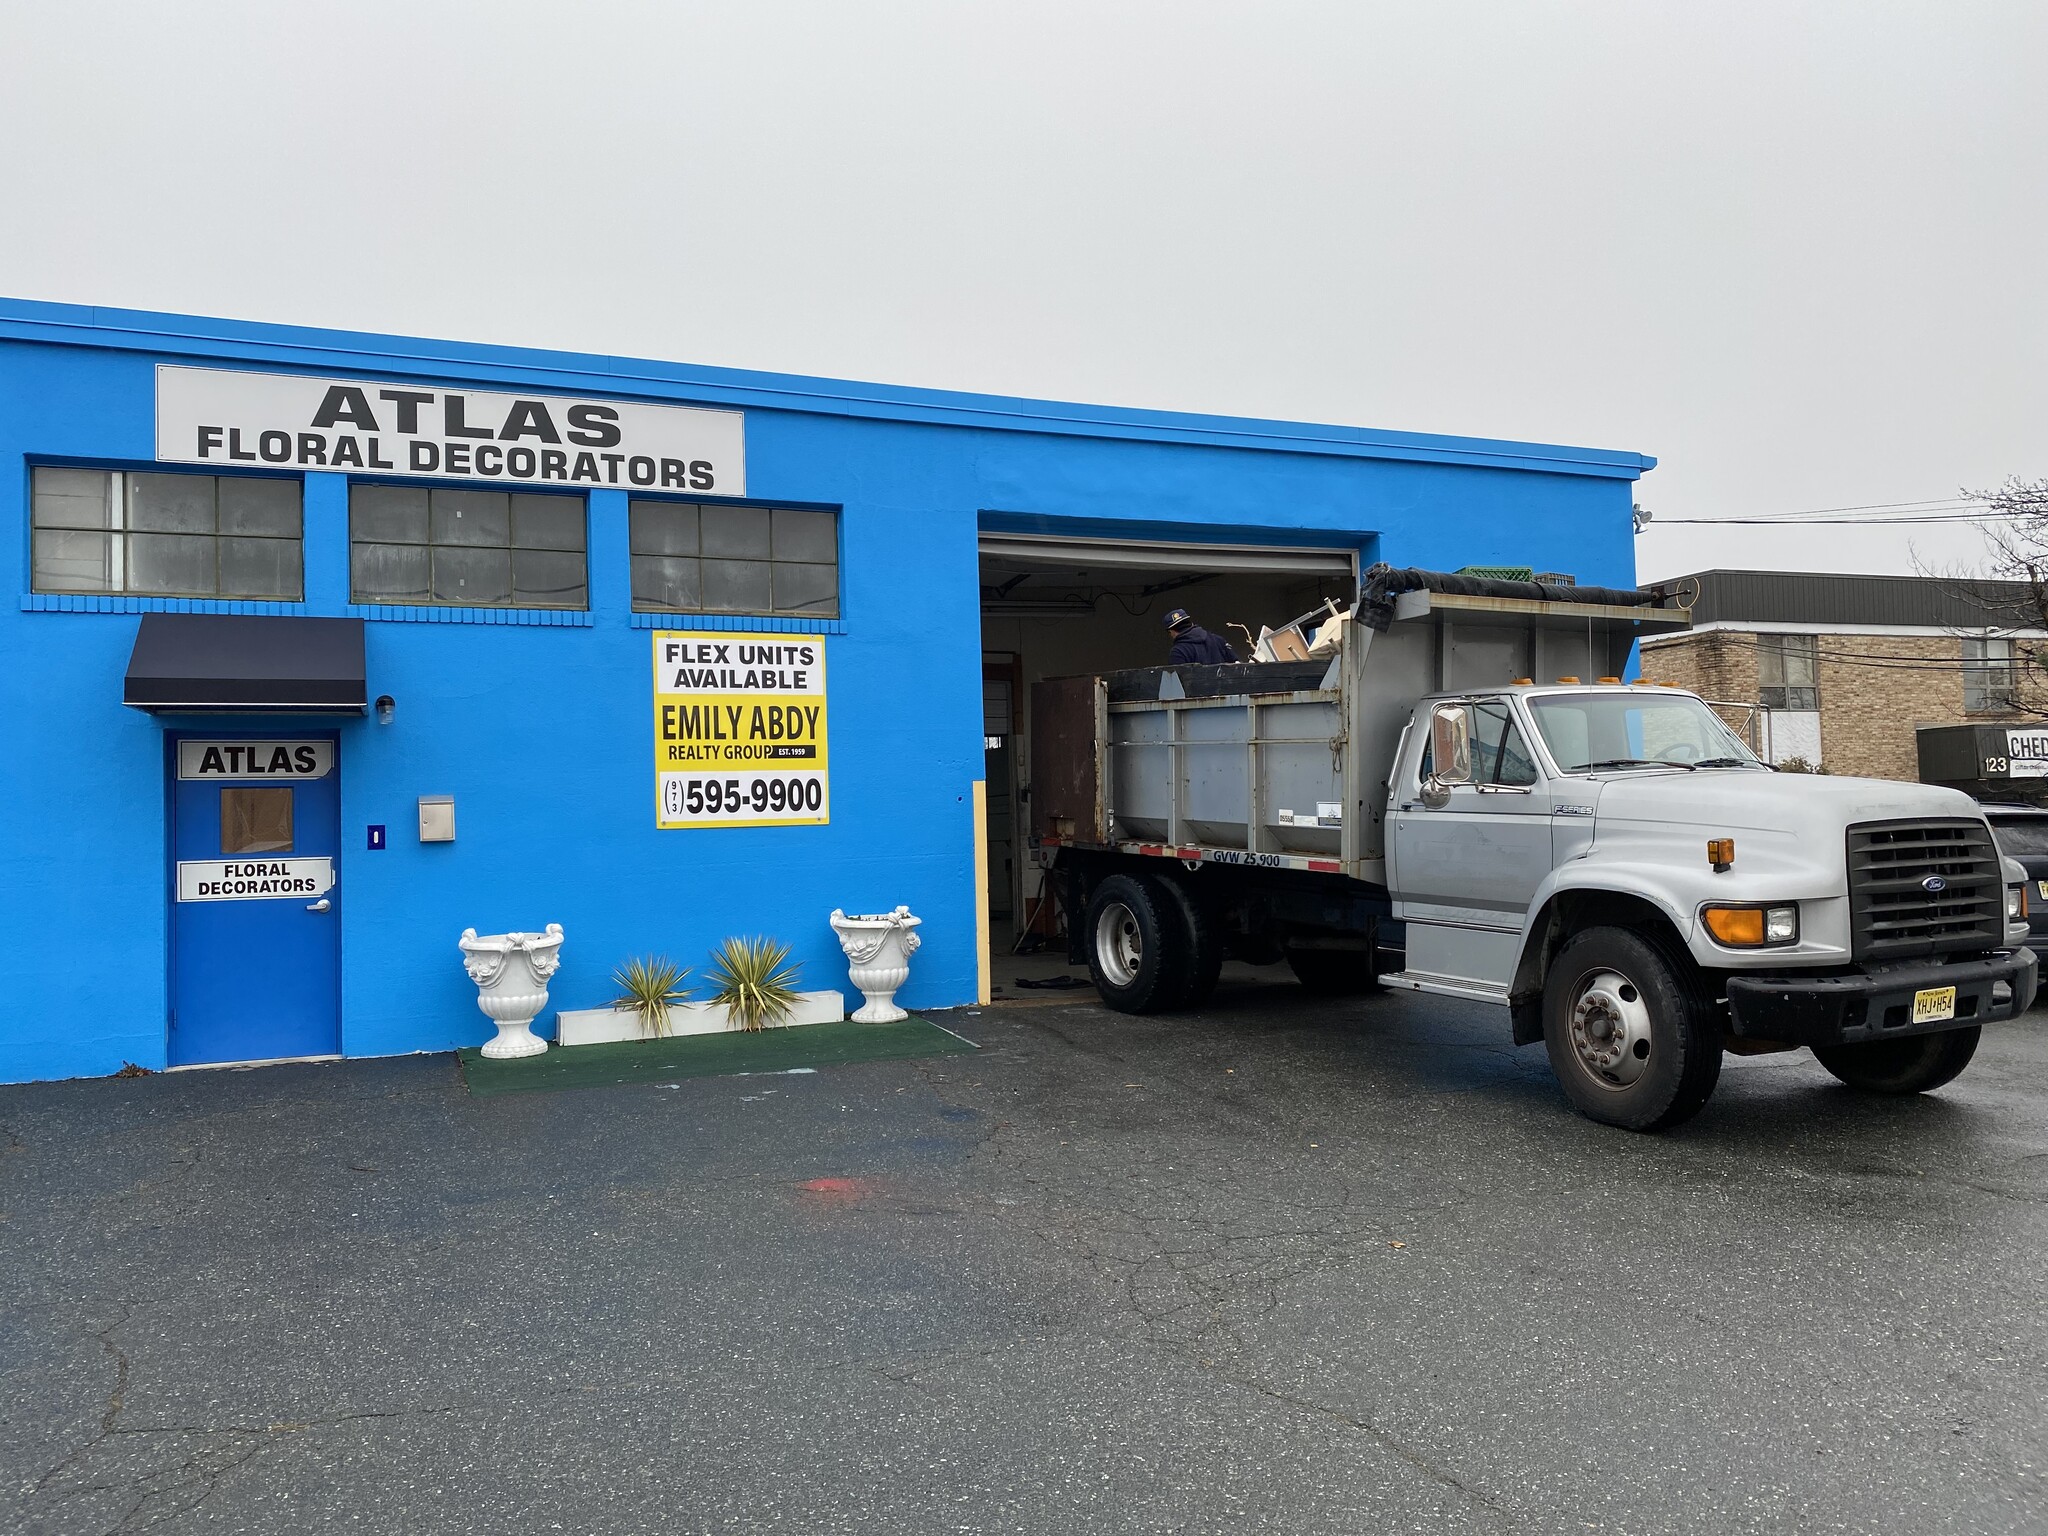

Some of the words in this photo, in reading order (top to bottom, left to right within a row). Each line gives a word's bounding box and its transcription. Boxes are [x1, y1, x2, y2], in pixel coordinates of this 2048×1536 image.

[310, 385, 621, 448] ATLAS
[198, 425, 394, 470] FLORAL
[409, 442, 715, 490] DECORATORS
[665, 644, 731, 664] FLEX
[739, 645, 814, 666] UNITS
[674, 669, 808, 689] AVAILABLE
[662, 705, 743, 740] EMILY
[749, 705, 820, 740] ABDY
[198, 746, 317, 774] ATLAS
[668, 745, 721, 760] REALTY
[724, 745, 772, 760] GROUP
[791, 748, 806, 756] 1959
[1985, 757, 2007, 772] 123
[686, 778, 822, 814] 595-9900
[1213, 850, 1240, 864] GVW
[224, 863, 290, 878] FLORAL
[198, 878, 316, 896] DECORATORS
